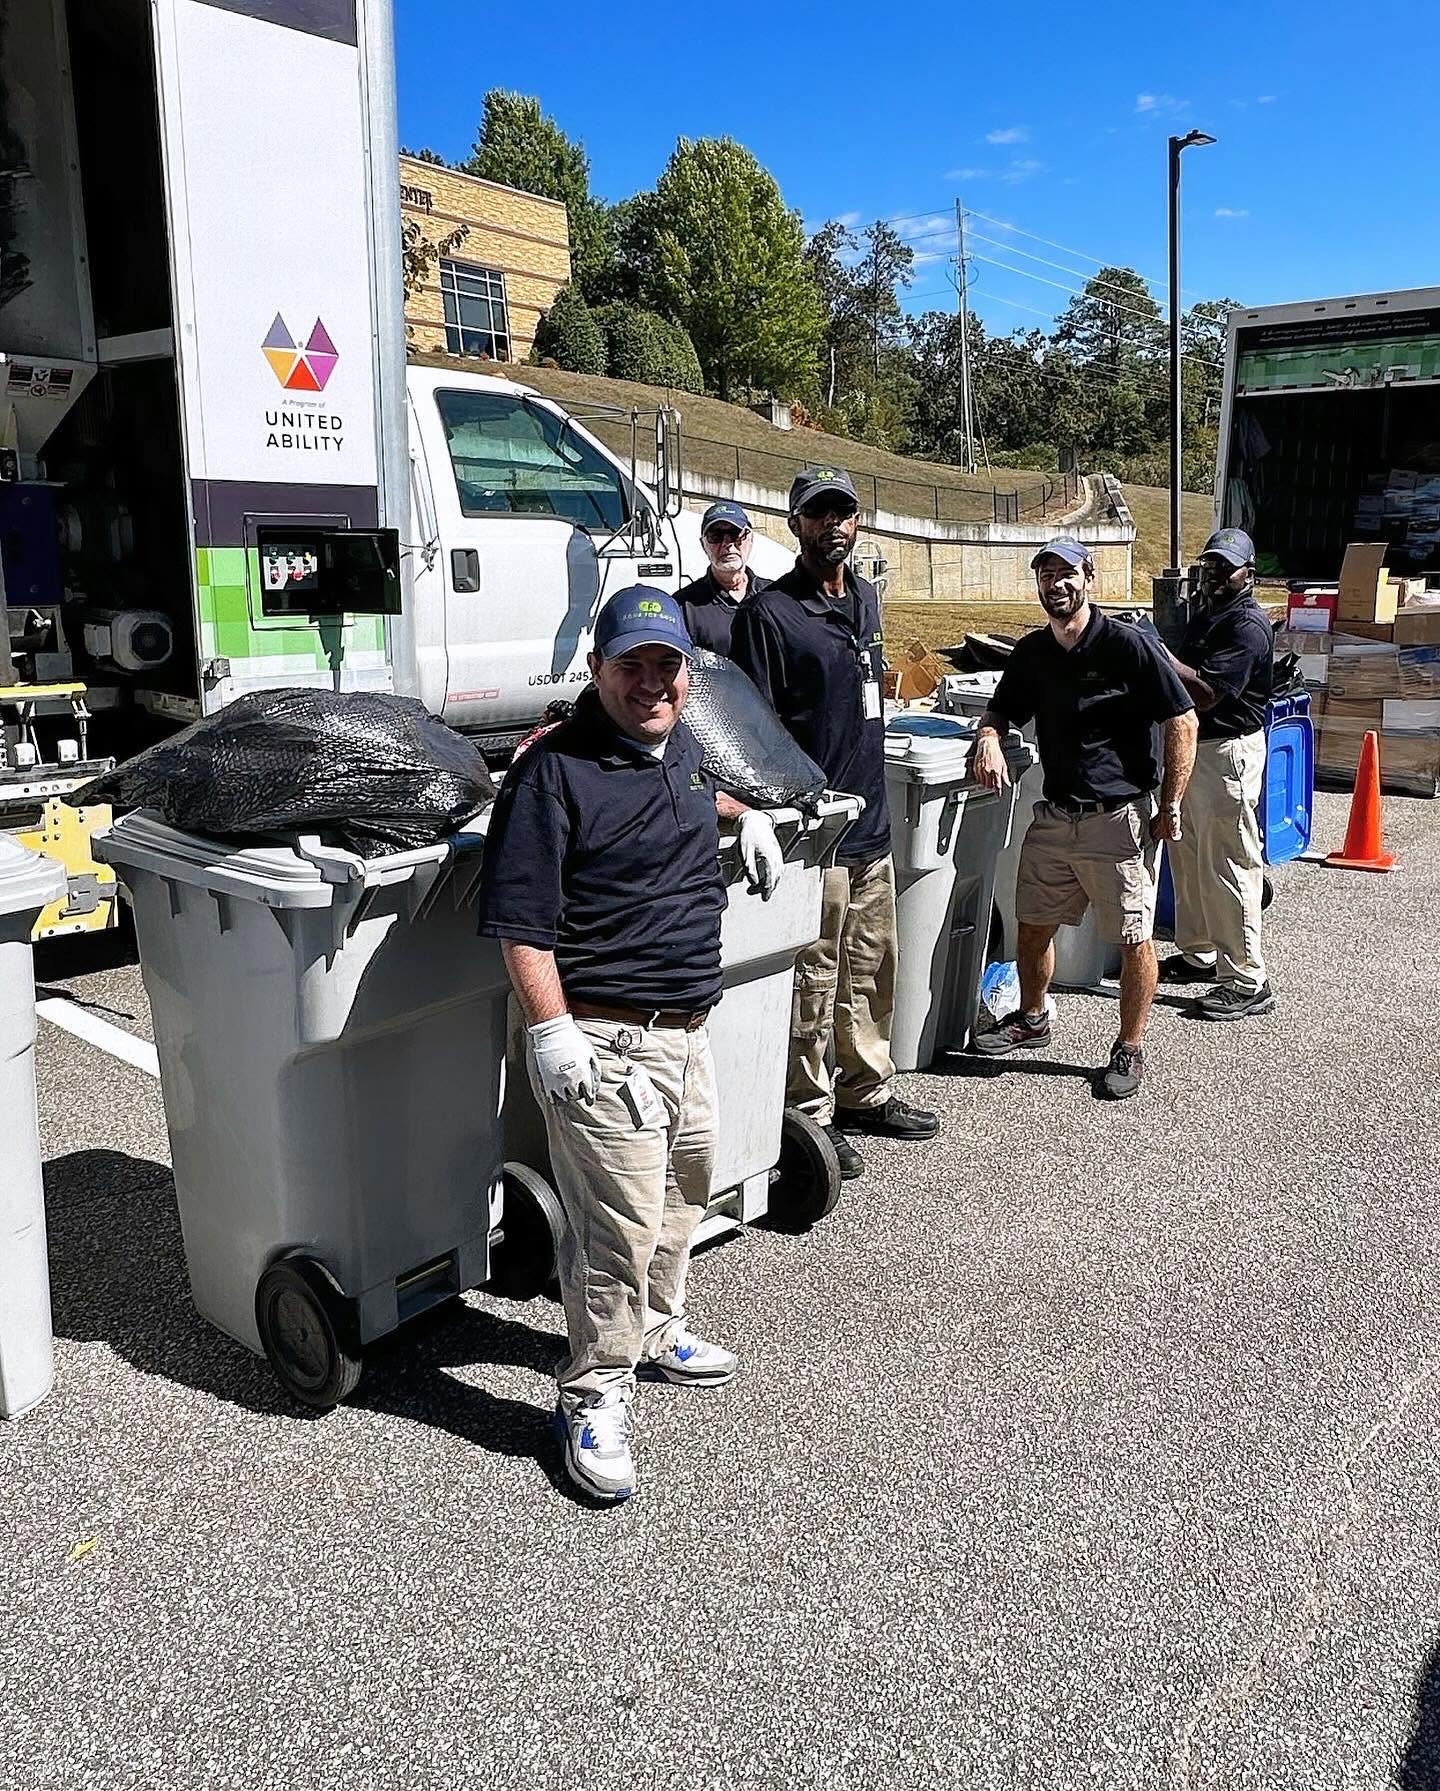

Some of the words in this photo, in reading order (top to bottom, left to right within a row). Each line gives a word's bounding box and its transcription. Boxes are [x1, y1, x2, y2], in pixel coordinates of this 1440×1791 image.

[266, 411, 342, 430] UNITED
[266, 433, 344, 451] ABILITY
[528, 672, 566, 686] USDOT
[569, 671, 593, 683] 245
